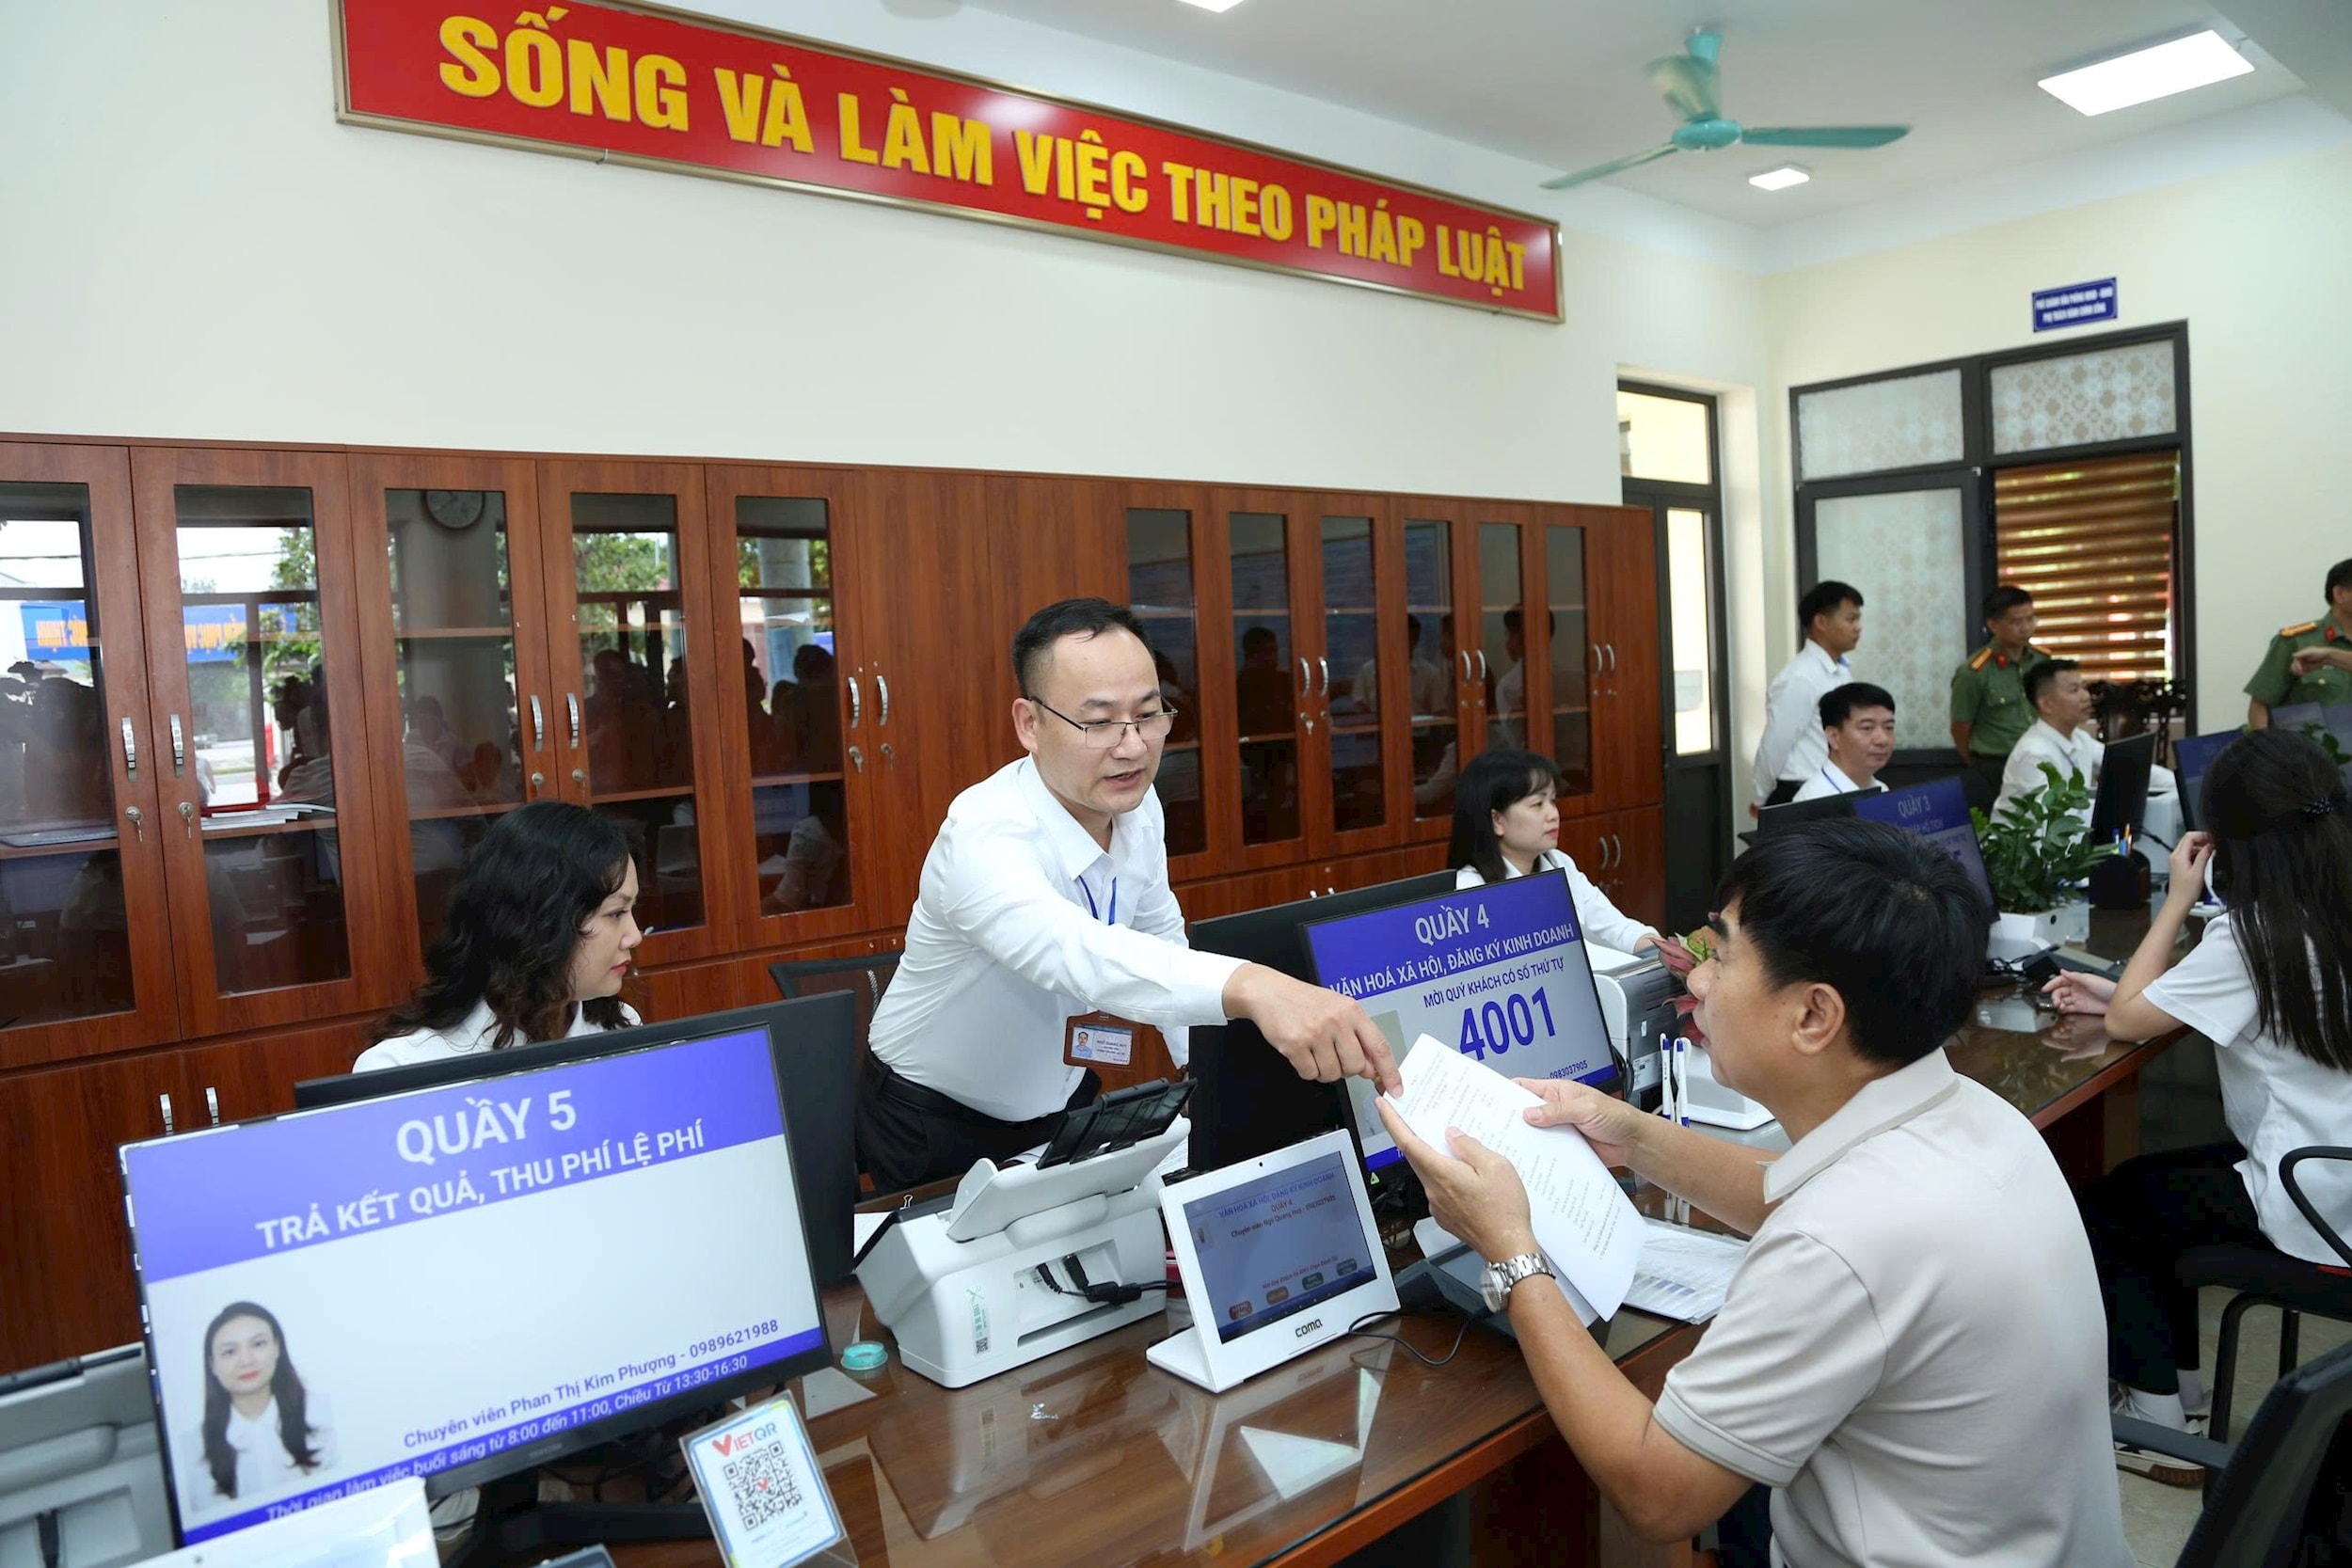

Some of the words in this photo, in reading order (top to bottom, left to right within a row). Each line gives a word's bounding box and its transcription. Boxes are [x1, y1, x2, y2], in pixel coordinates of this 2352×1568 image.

[440, 7, 689, 131] SỐNG
[716, 65, 814, 152] VÀ
[839, 88, 993, 185] LÀM
[1017, 129, 1148, 219] VIỆC
[1163, 162, 1293, 241] THEO
[1308, 196, 1425, 266] PHÁP
[1438, 226, 1526, 297] LUẬT
[1329, 976, 1363, 997] VĂN
[1364, 966, 1396, 990] HOÁ
[1398, 960, 1416, 983] XÃ
[1418, 955, 1447, 979] HỘI,
[1447, 947, 1484, 972] ĐĂNG
[1484, 939, 1502, 961] KÝ
[1503, 933, 1534, 957] KINH
[1534, 923, 1574, 946] DOANH
[1415, 905, 1470, 946] QUẦY
[1477, 904, 1490, 929] 4
[1423, 990, 1445, 1007] MỜI
[1446, 982, 1466, 1001] QUÝ
[1469, 974, 1502, 996] KHÁCH
[1502, 968, 1517, 986] CÓ
[1518, 963, 1531, 981] SỐ
[1531, 958, 1551, 977] THỨ
[1550, 956, 1565, 972] TỰ
[1460, 986, 1556, 1061] 4001
[396, 1097, 532, 1165] QUẦY
[548, 1089, 577, 1132] 5
[255, 1203, 329, 1249] TRẢ
[336, 1190, 399, 1231] KẾT
[409, 1170, 485, 1214] QUẢ,
[490, 1159, 554, 1194] THU
[562, 1139, 612, 1180] PHÍ
[617, 1132, 652, 1166] LỆ
[657, 1118, 705, 1157] PHÍ
[404, 1418, 468, 1449] Chuyên
[472, 1407, 506, 1427] viên
[511, 1392, 551, 1415] Phan
[554, 1381, 580, 1399] Thị
[584, 1373, 614, 1391] Kim
[618, 1353, 676, 1381] Phượng
[690, 1319, 779, 1358] 0989621988
[413, 1453, 446, 1477] buổi
[450, 1443, 485, 1465] sáng
[489, 1434, 506, 1451] từ
[508, 1422, 539, 1446] 8:00
[542, 1415, 567, 1434] đến
[571, 1400, 612, 1424] 11:00,
[614, 1388, 651, 1411] Chiều
[675, 1354, 748, 1390] 13:30-16:30
[711, 1422, 778, 1457] VIETQR
